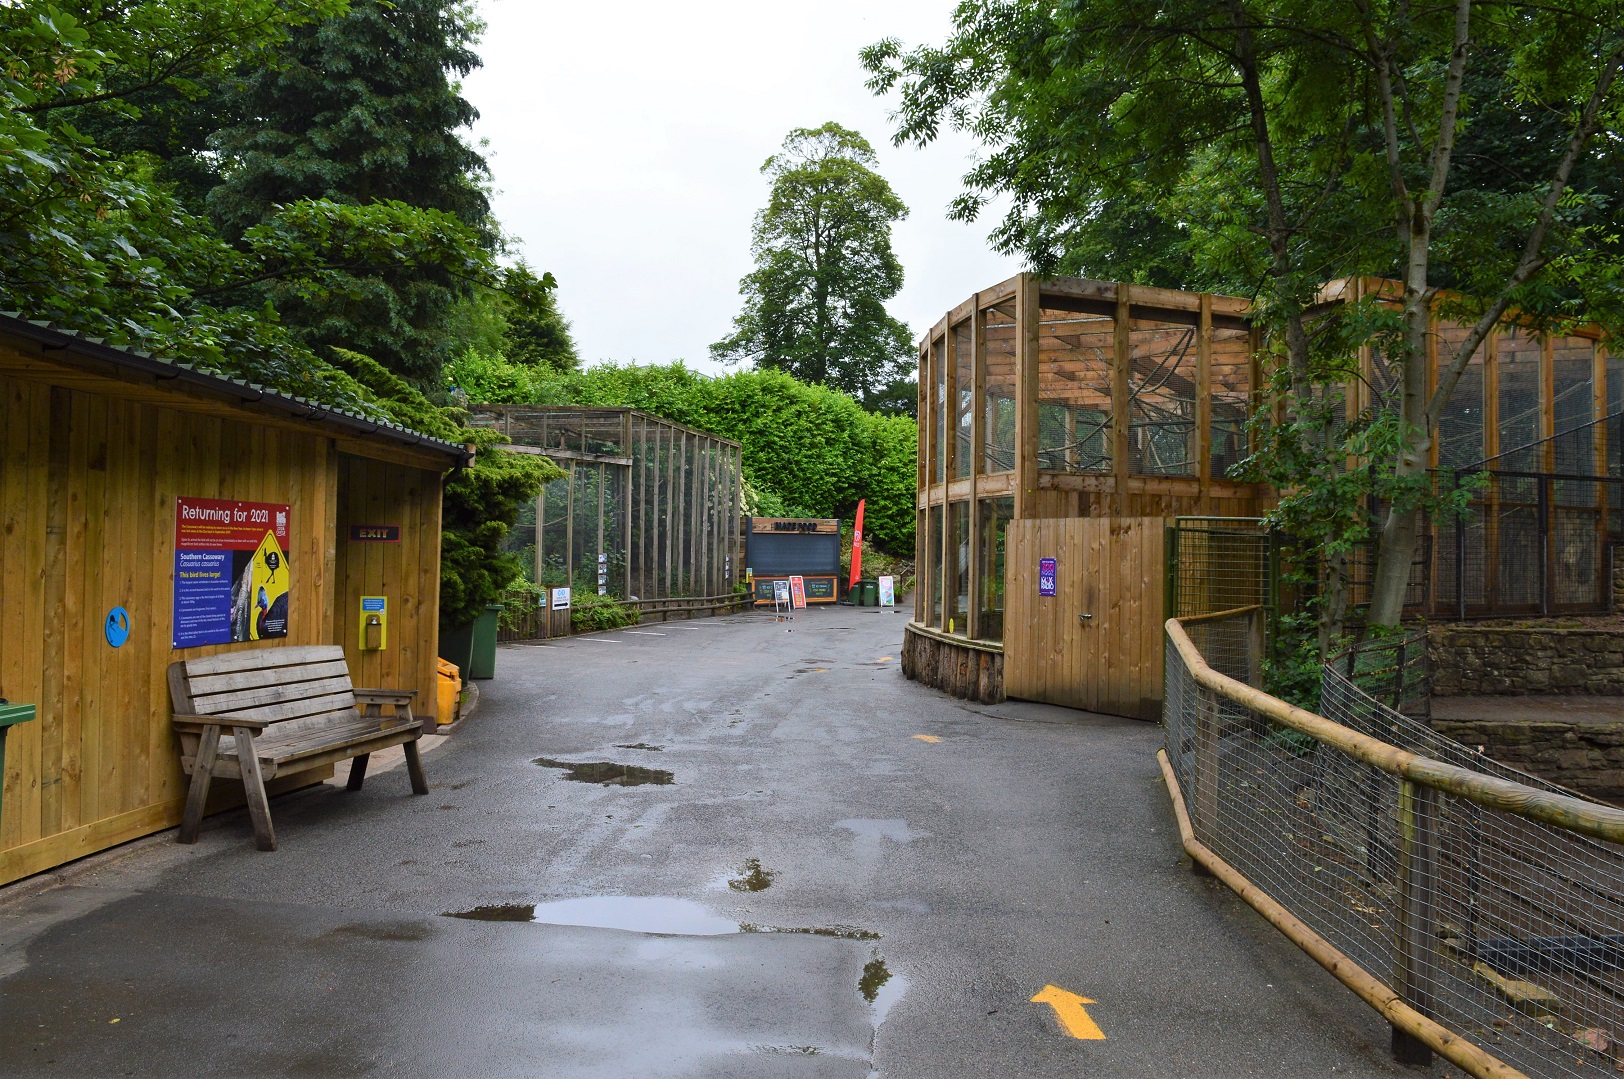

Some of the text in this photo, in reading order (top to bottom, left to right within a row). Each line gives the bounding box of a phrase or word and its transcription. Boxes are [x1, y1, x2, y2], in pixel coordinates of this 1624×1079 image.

[182, 504, 268, 524] Returning for 2021
[359, 528, 389, 538] EXIT
[180, 552, 225, 562] Southern Cassowary
